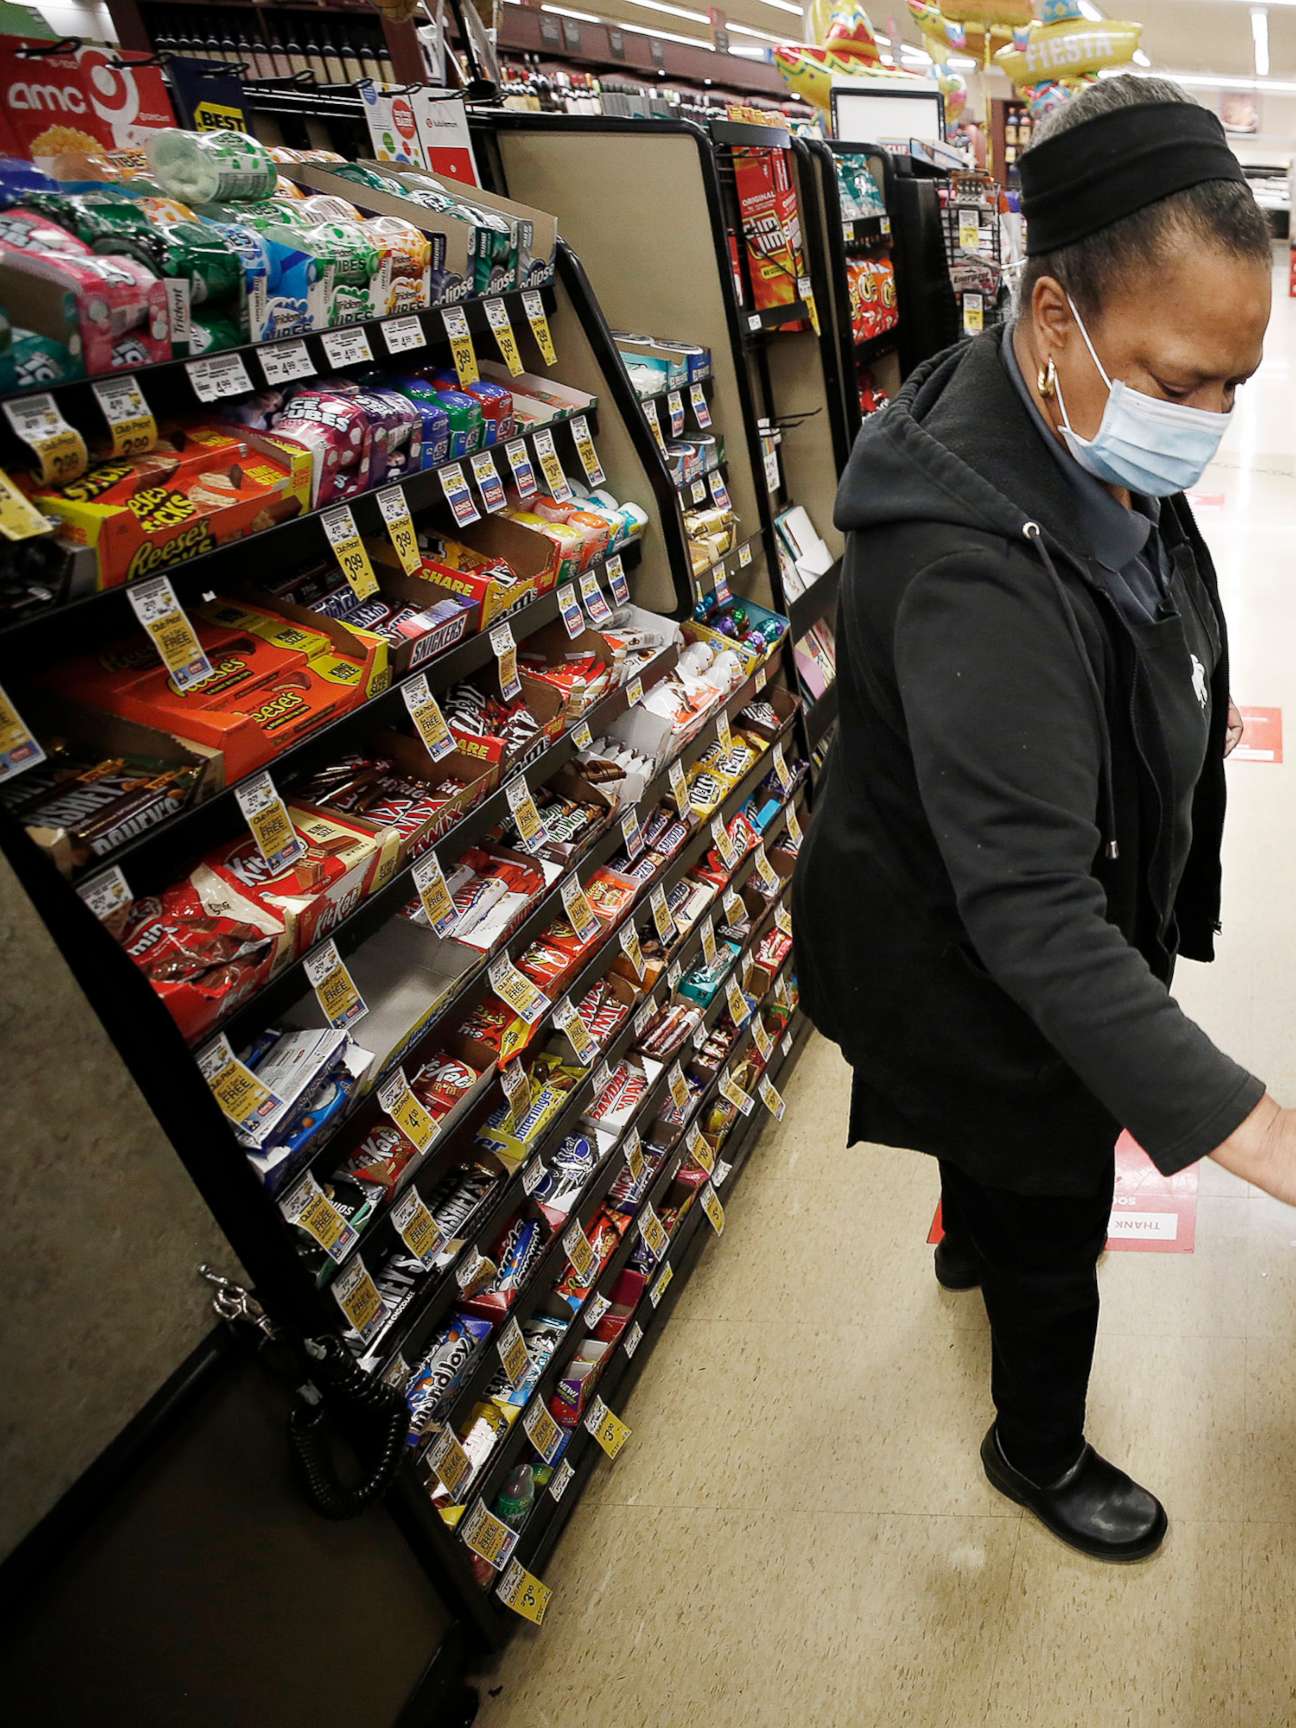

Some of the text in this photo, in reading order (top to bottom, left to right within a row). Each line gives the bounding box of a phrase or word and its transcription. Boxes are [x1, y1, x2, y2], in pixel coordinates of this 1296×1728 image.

[1023, 33, 1114, 73] FIESTA
[8, 82, 87, 114] amc
[201, 110, 244, 132] BEST
[742, 191, 776, 206] ORIGINAL
[174, 287, 185, 335] Trident
[128, 517, 210, 580] Reese's
[418, 568, 475, 598] SHARE
[412, 612, 467, 663] SNICKERS
[1114, 1219, 1161, 1231] THANK
